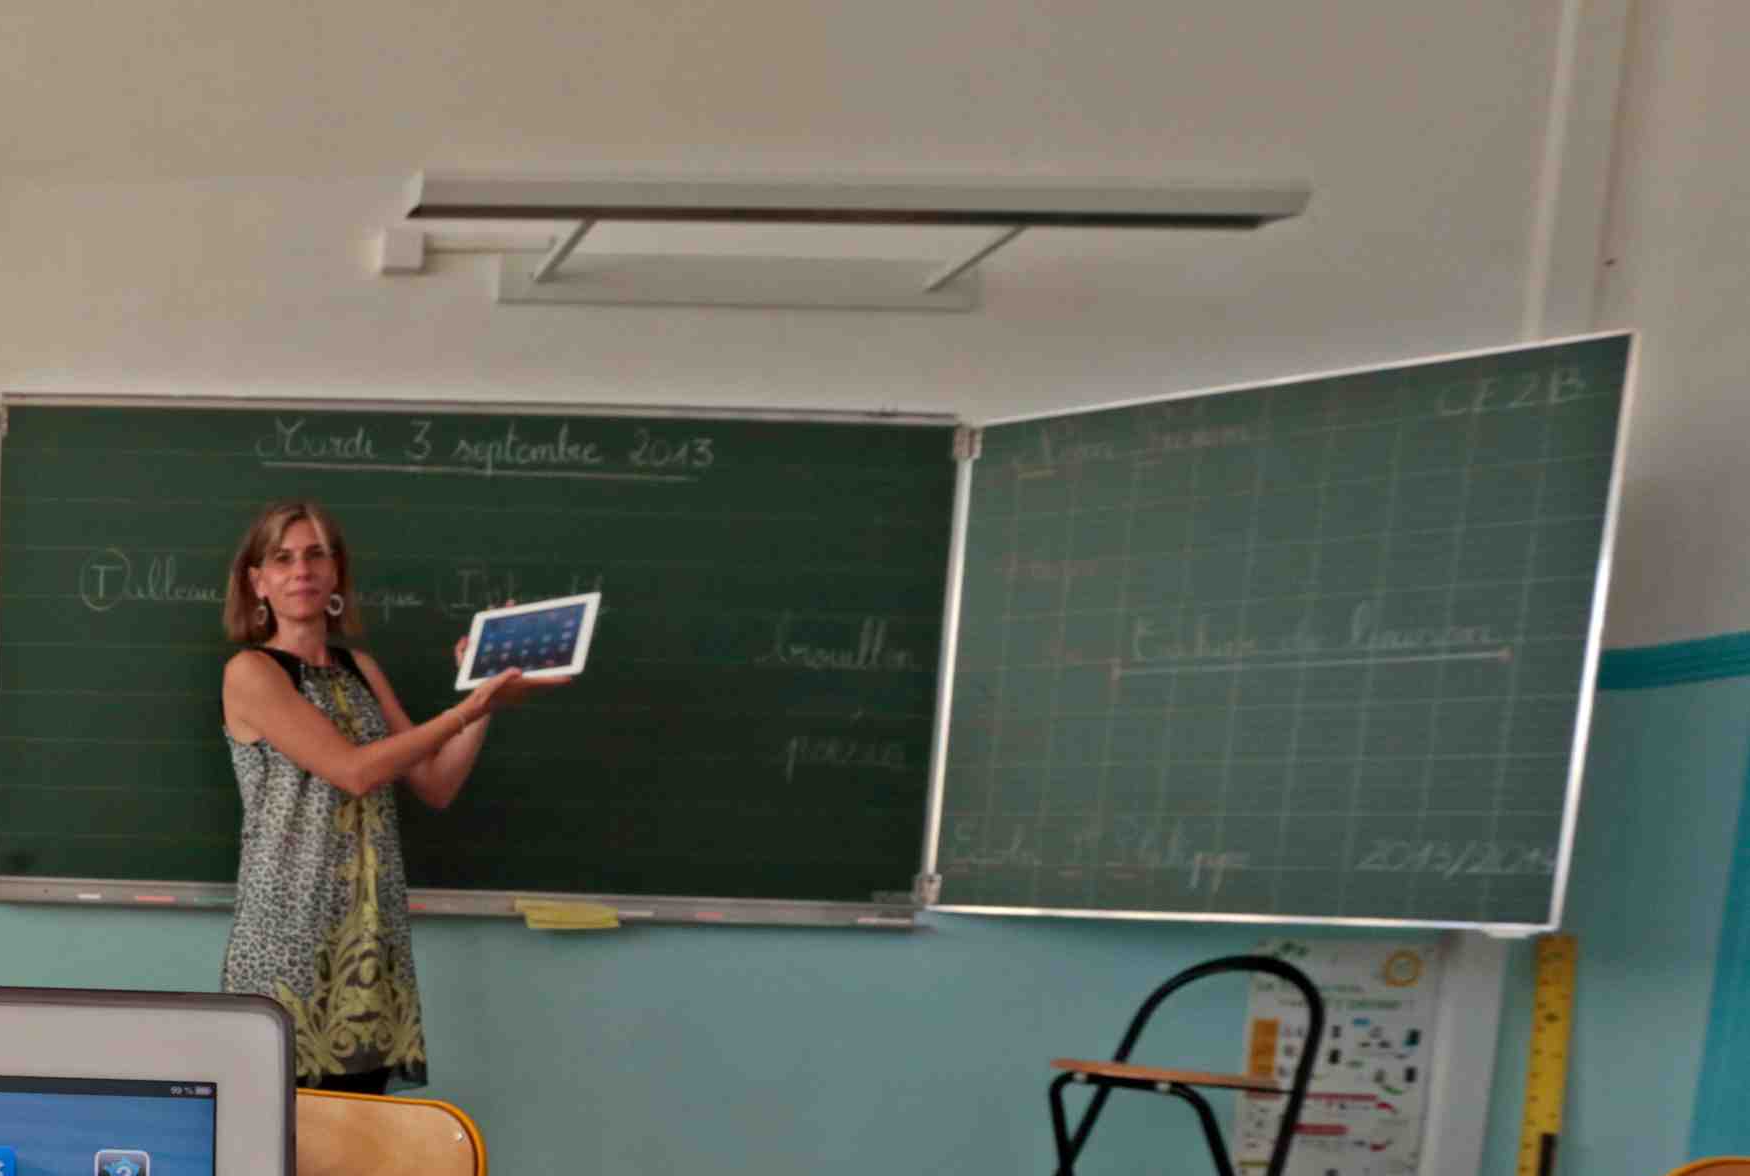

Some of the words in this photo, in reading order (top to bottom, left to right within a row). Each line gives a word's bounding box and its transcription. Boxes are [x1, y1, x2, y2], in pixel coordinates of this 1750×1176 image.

[255, 417, 378, 460] Mardi
[408, 420, 432, 461] 3
[452, 423, 602, 476] septembre
[629, 428, 715, 468] 2013
